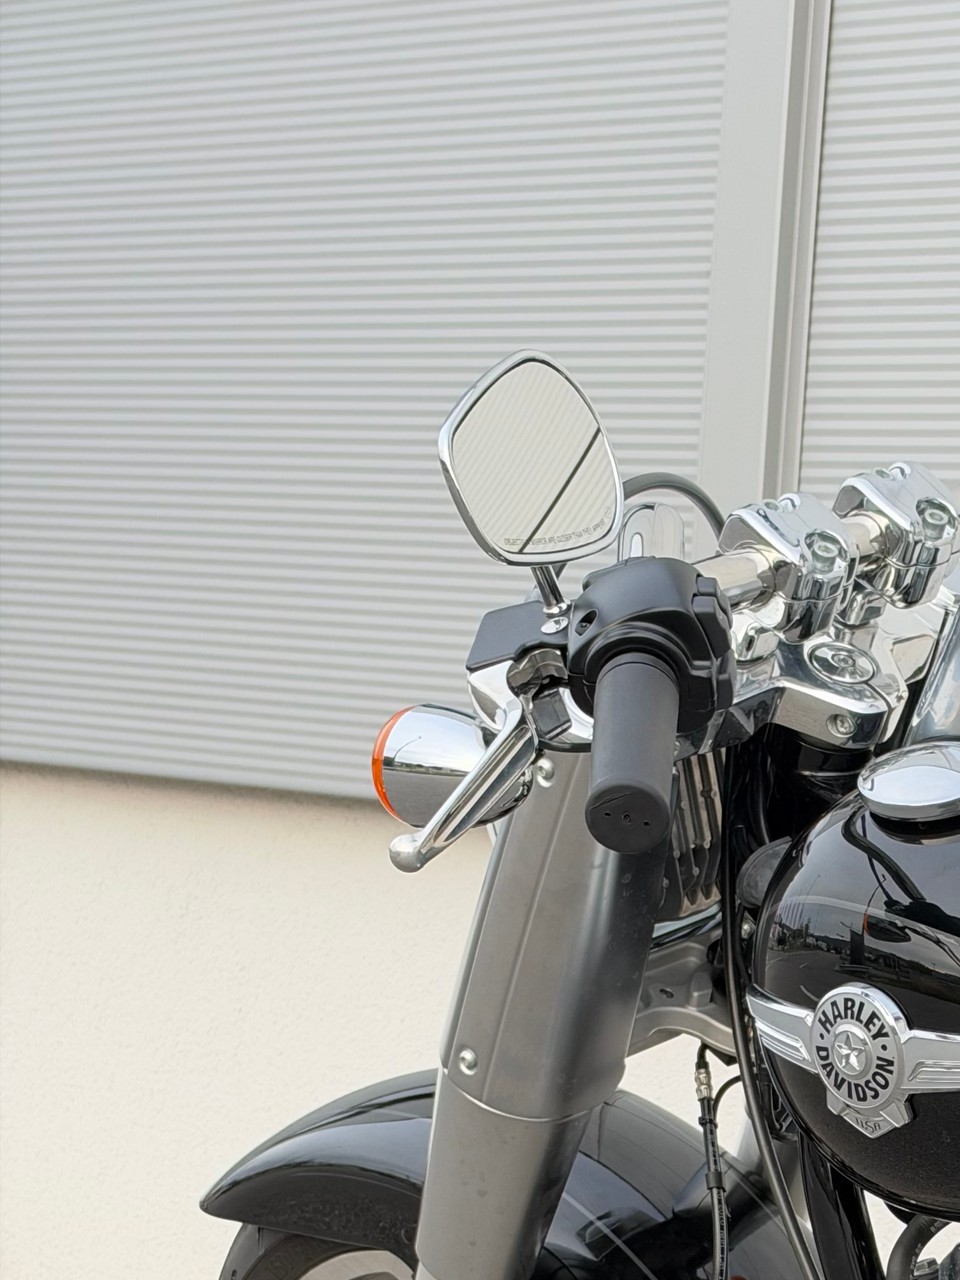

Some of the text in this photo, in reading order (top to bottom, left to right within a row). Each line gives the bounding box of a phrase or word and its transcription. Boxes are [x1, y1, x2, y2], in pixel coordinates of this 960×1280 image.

[817, 997, 890, 1042] HARLEY
[815, 1045, 896, 1103] DAVIDSON
[855, 1116, 882, 1134] USA
